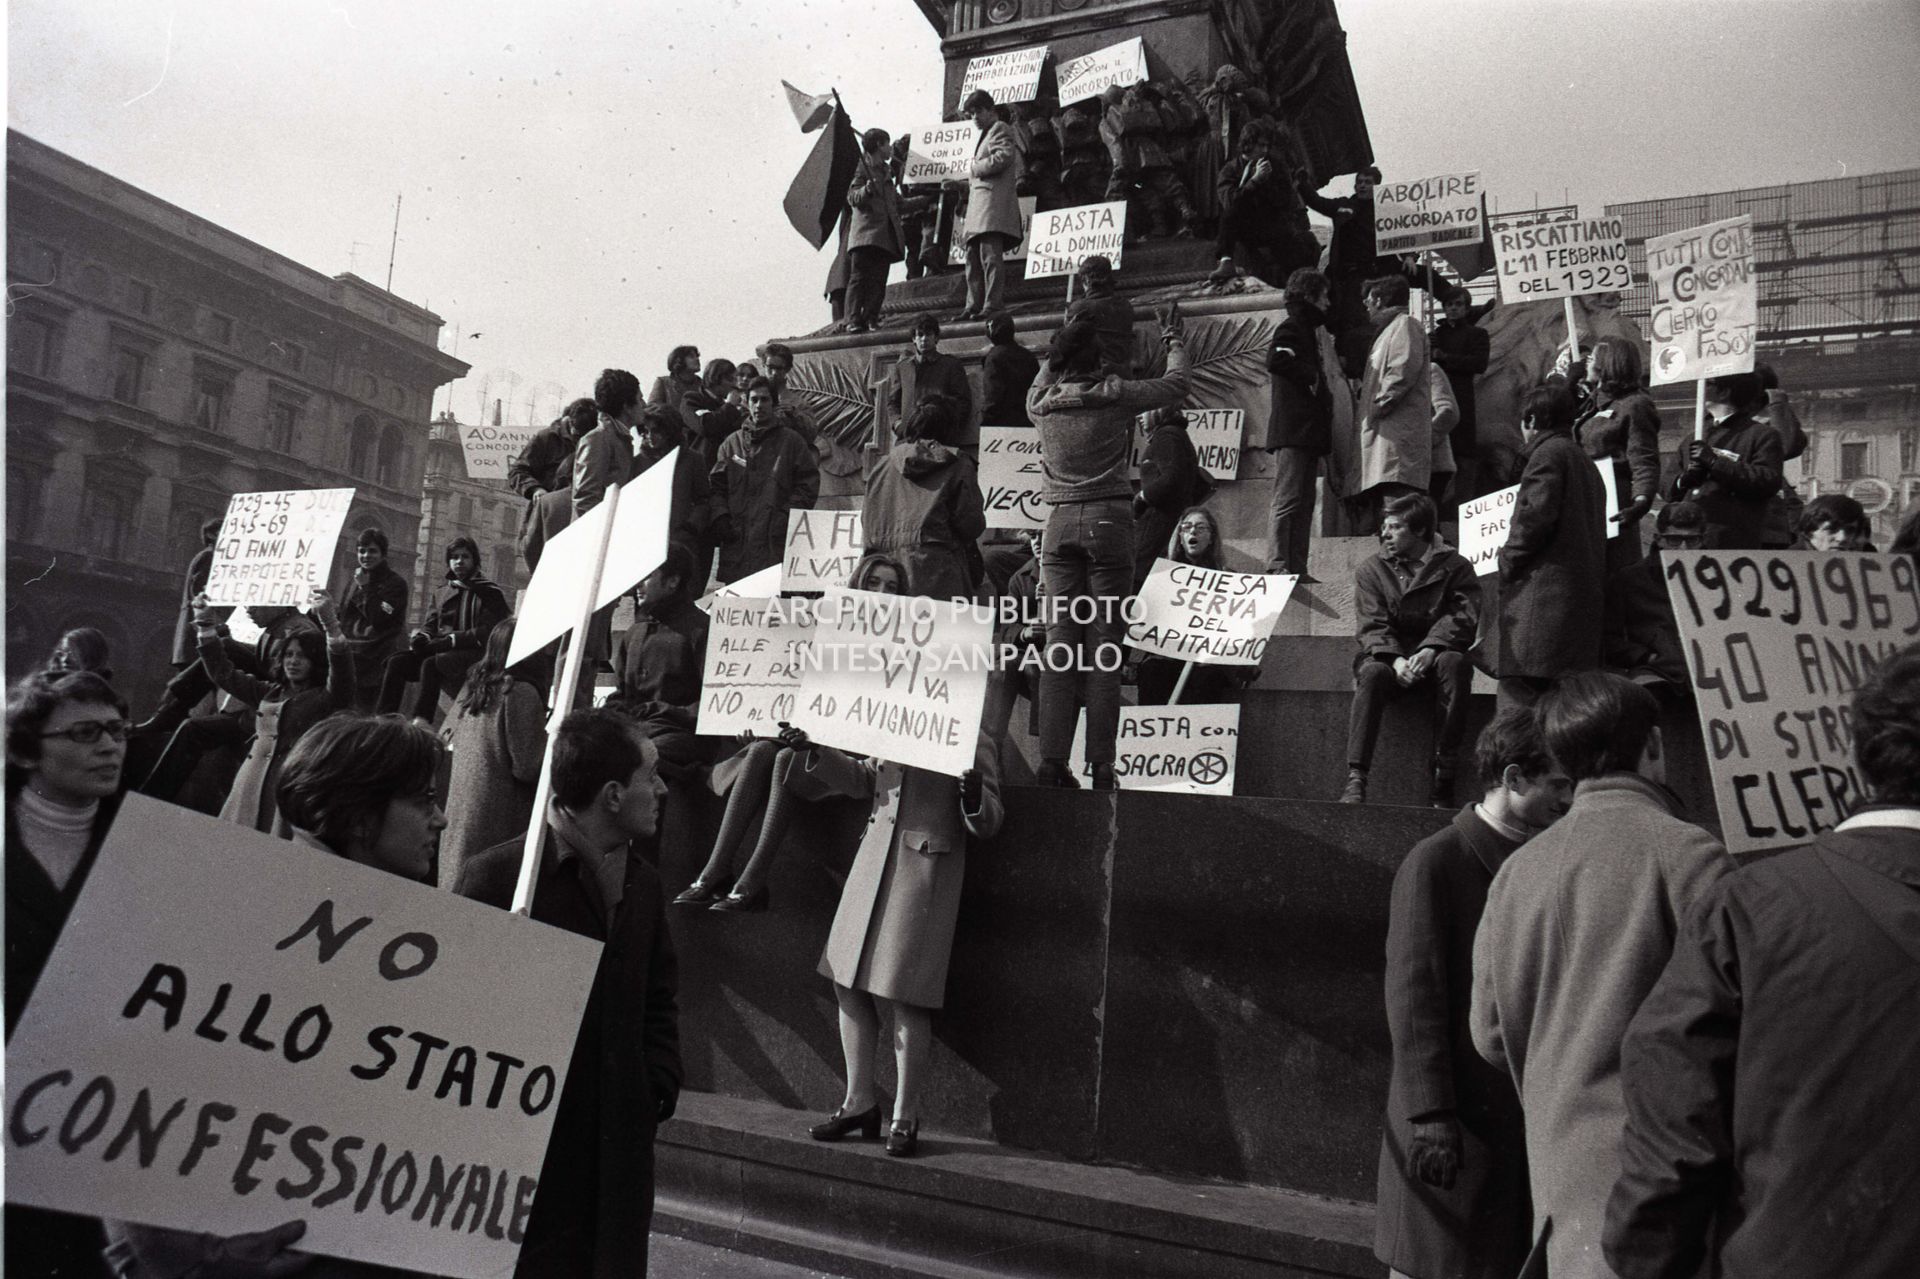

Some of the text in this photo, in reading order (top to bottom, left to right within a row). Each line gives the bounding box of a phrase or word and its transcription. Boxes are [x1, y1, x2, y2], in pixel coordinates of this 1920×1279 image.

[969, 57, 994, 70] NON
[923, 127, 972, 145] BASTA
[932, 147, 963, 159] CON LO
[1380, 175, 1476, 204] ABOLIRE
[1050, 208, 1115, 236] BASTA
[1376, 206, 1478, 232] CONCORDATO
[1035, 240, 1061, 254] COL
[1501, 219, 1623, 253] RISCATTIAMO
[1031, 256, 1073, 275] DELLA
[1546, 242, 1627, 269] FEBBRAIO
[1519, 263, 1631, 294] DEL 1929
[1186, 409, 1241, 430] PATTI
[984, 439, 1003, 453] IL
[473, 458, 500, 467] ORA
[230, 493, 296, 513] 1929-45
[1464, 501, 1491, 519] SUL
[221, 514, 288, 535] 1945-69
[789, 510, 815, 550] A
[215, 538, 313, 560] 40 ANNI DI
[211, 563, 316, 582] STRAPOTERE
[1169, 565, 1268, 596] CHIESA
[211, 582, 320, 606] CLERICALE
[1170, 587, 1257, 620] SERVA
[837, 596, 935, 648] PAOLO
[1188, 614, 1229, 633] DEL
[719, 638, 770, 654] ALLE
[1126, 621, 1268, 662] CAPITALISMO
[715, 661, 751, 677] DEI
[1692, 632, 1769, 710] 40
[708, 690, 743, 715] NO
[747, 708, 764, 721] AL
[809, 693, 962, 747] AD AVIGNONE
[1709, 718, 1750, 760] DI
[275, 899, 439, 982] NO
[121, 963, 556, 1117] ALLO STATO
[9, 1068, 540, 1245] CONFESSIONALE
